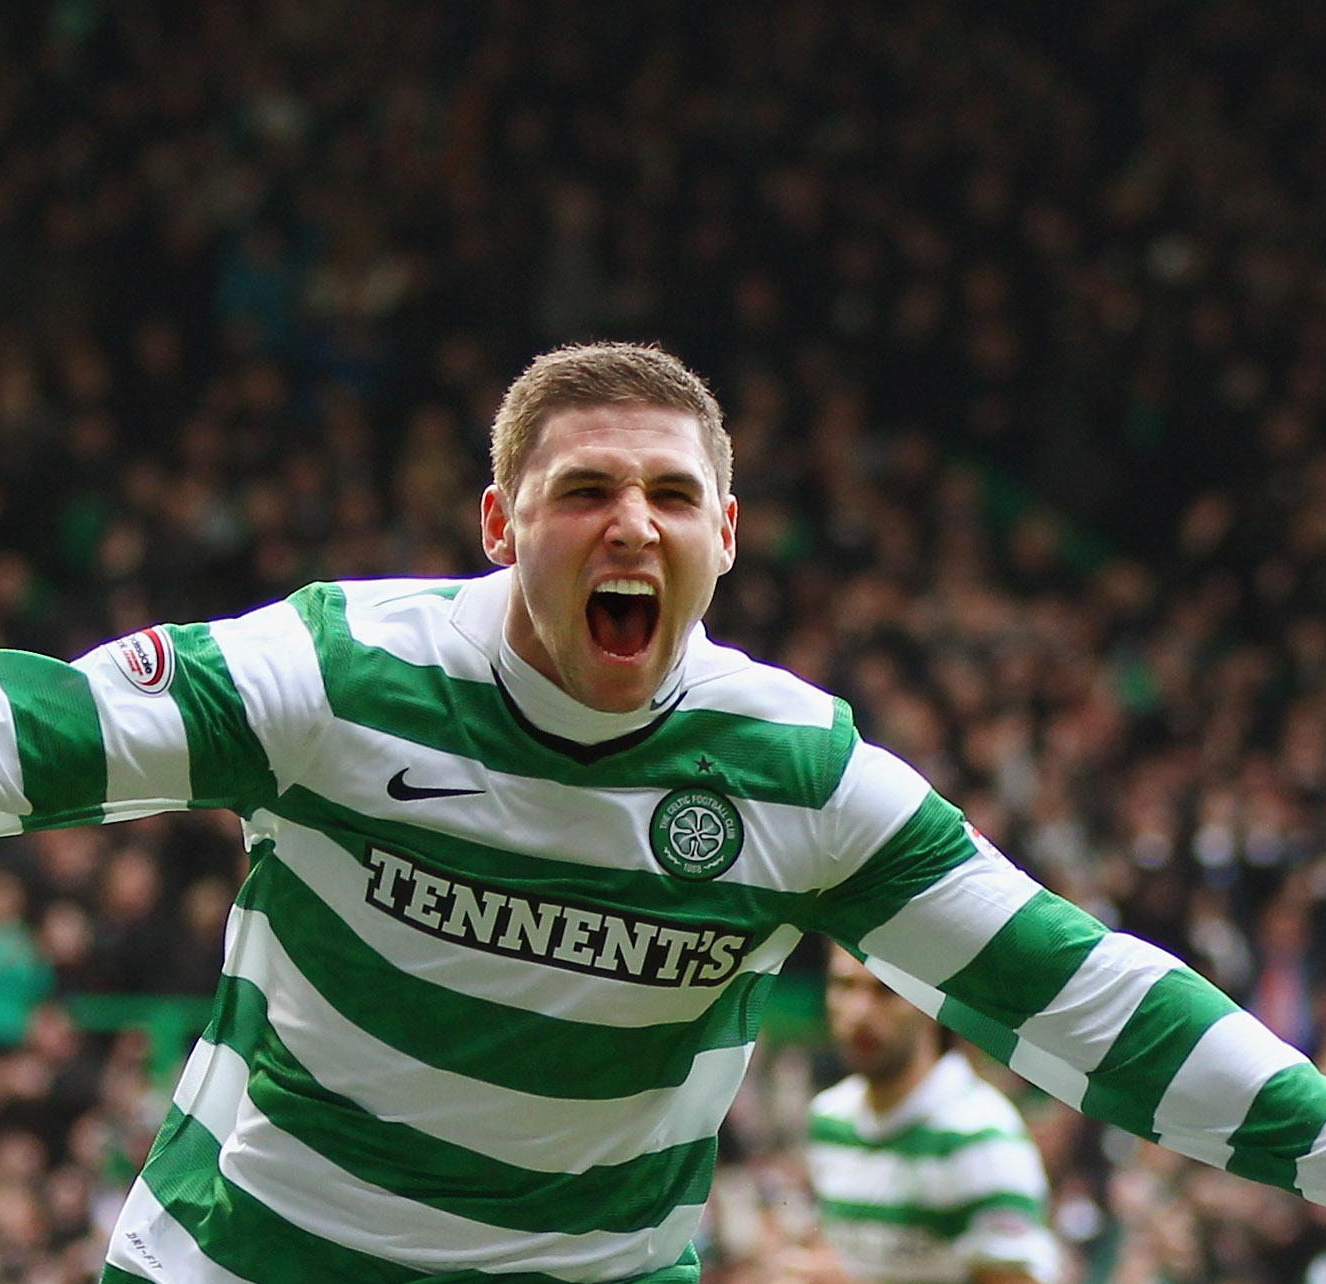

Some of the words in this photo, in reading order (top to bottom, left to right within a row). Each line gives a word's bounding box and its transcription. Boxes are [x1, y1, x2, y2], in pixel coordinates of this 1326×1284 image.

[659, 814, 672, 829] THE
[667, 795, 691, 815] CELTIC
[692, 795, 729, 819] FOOTBALL
[725, 818, 736, 839] CLUB
[369, 847, 746, 988] TENNENT'S
[125, 1231, 163, 1270] DRI-FIT
